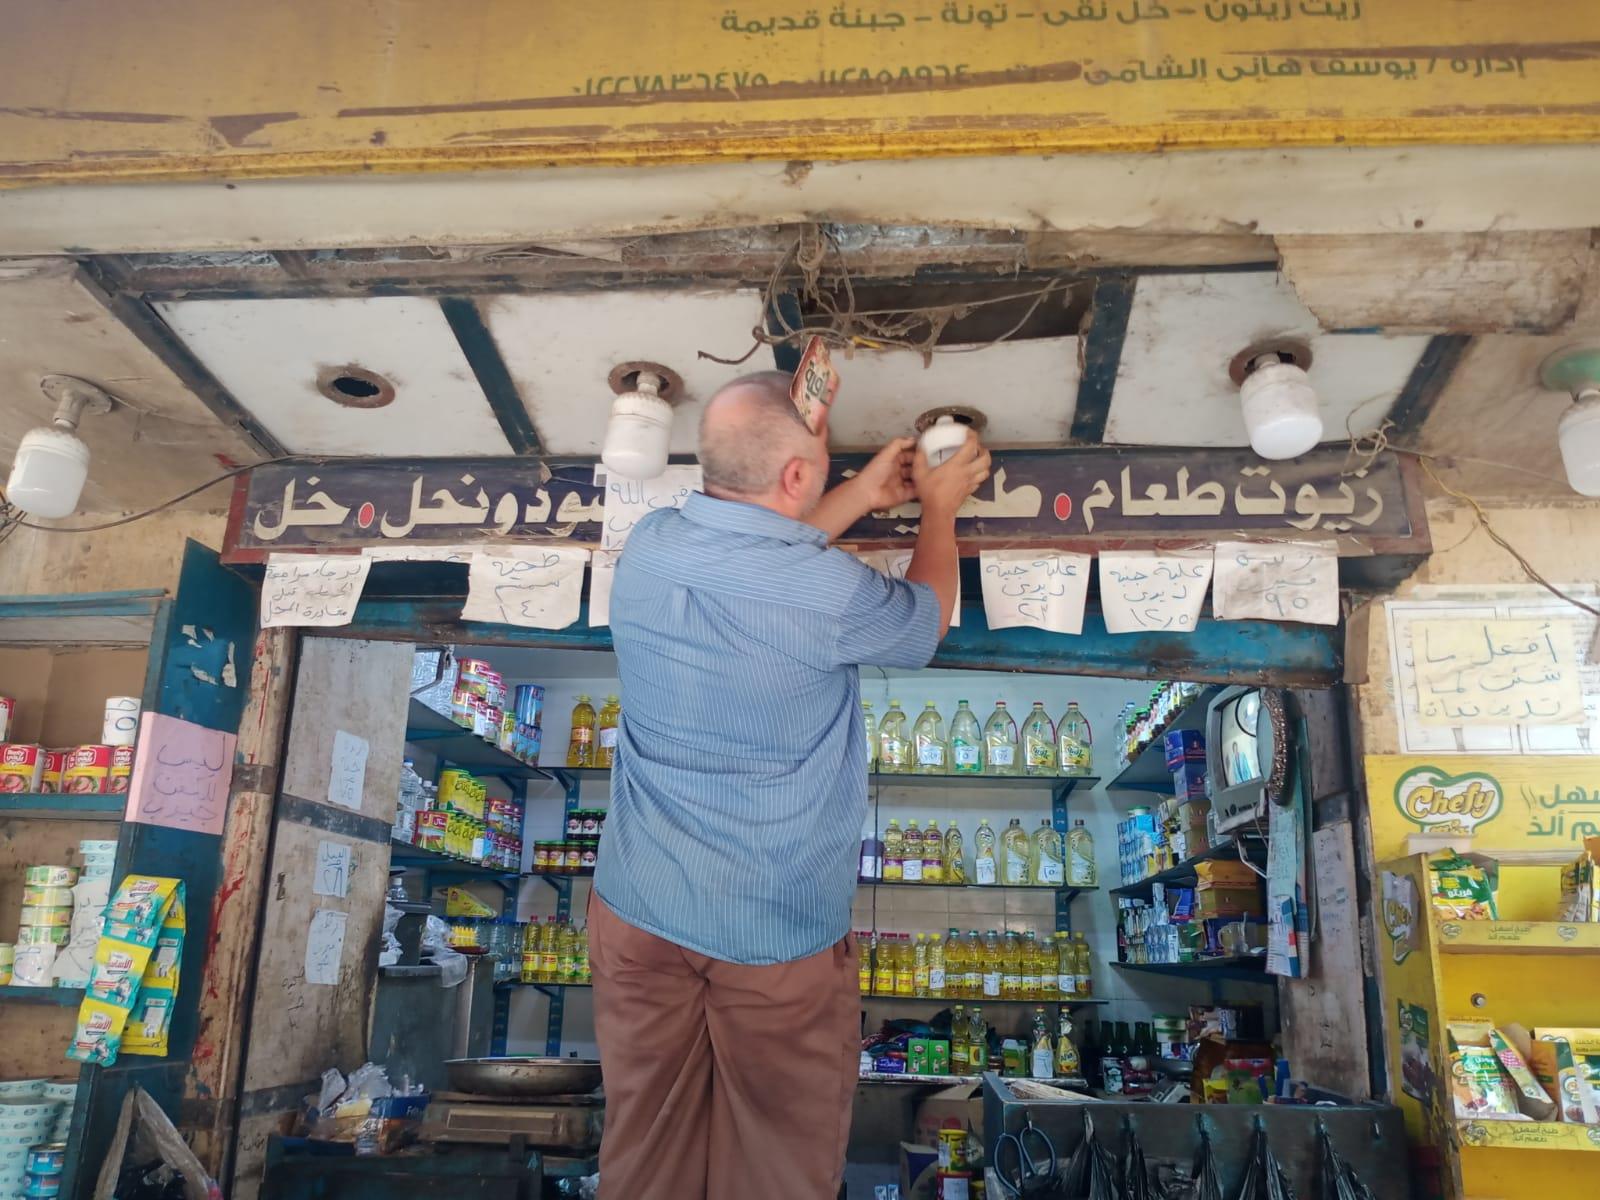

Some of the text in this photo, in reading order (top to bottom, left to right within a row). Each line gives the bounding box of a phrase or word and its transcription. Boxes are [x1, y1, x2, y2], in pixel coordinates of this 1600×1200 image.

[720, 8, 821, 34] قديمة
[828, 4, 906, 32] جبنة
[1309, 55, 1418, 81] يوسف
[1081, 464, 1226, 534] طعام
[1233, 466, 1385, 532] زيوت
[1405, 781, 1496, 818] Chefy
